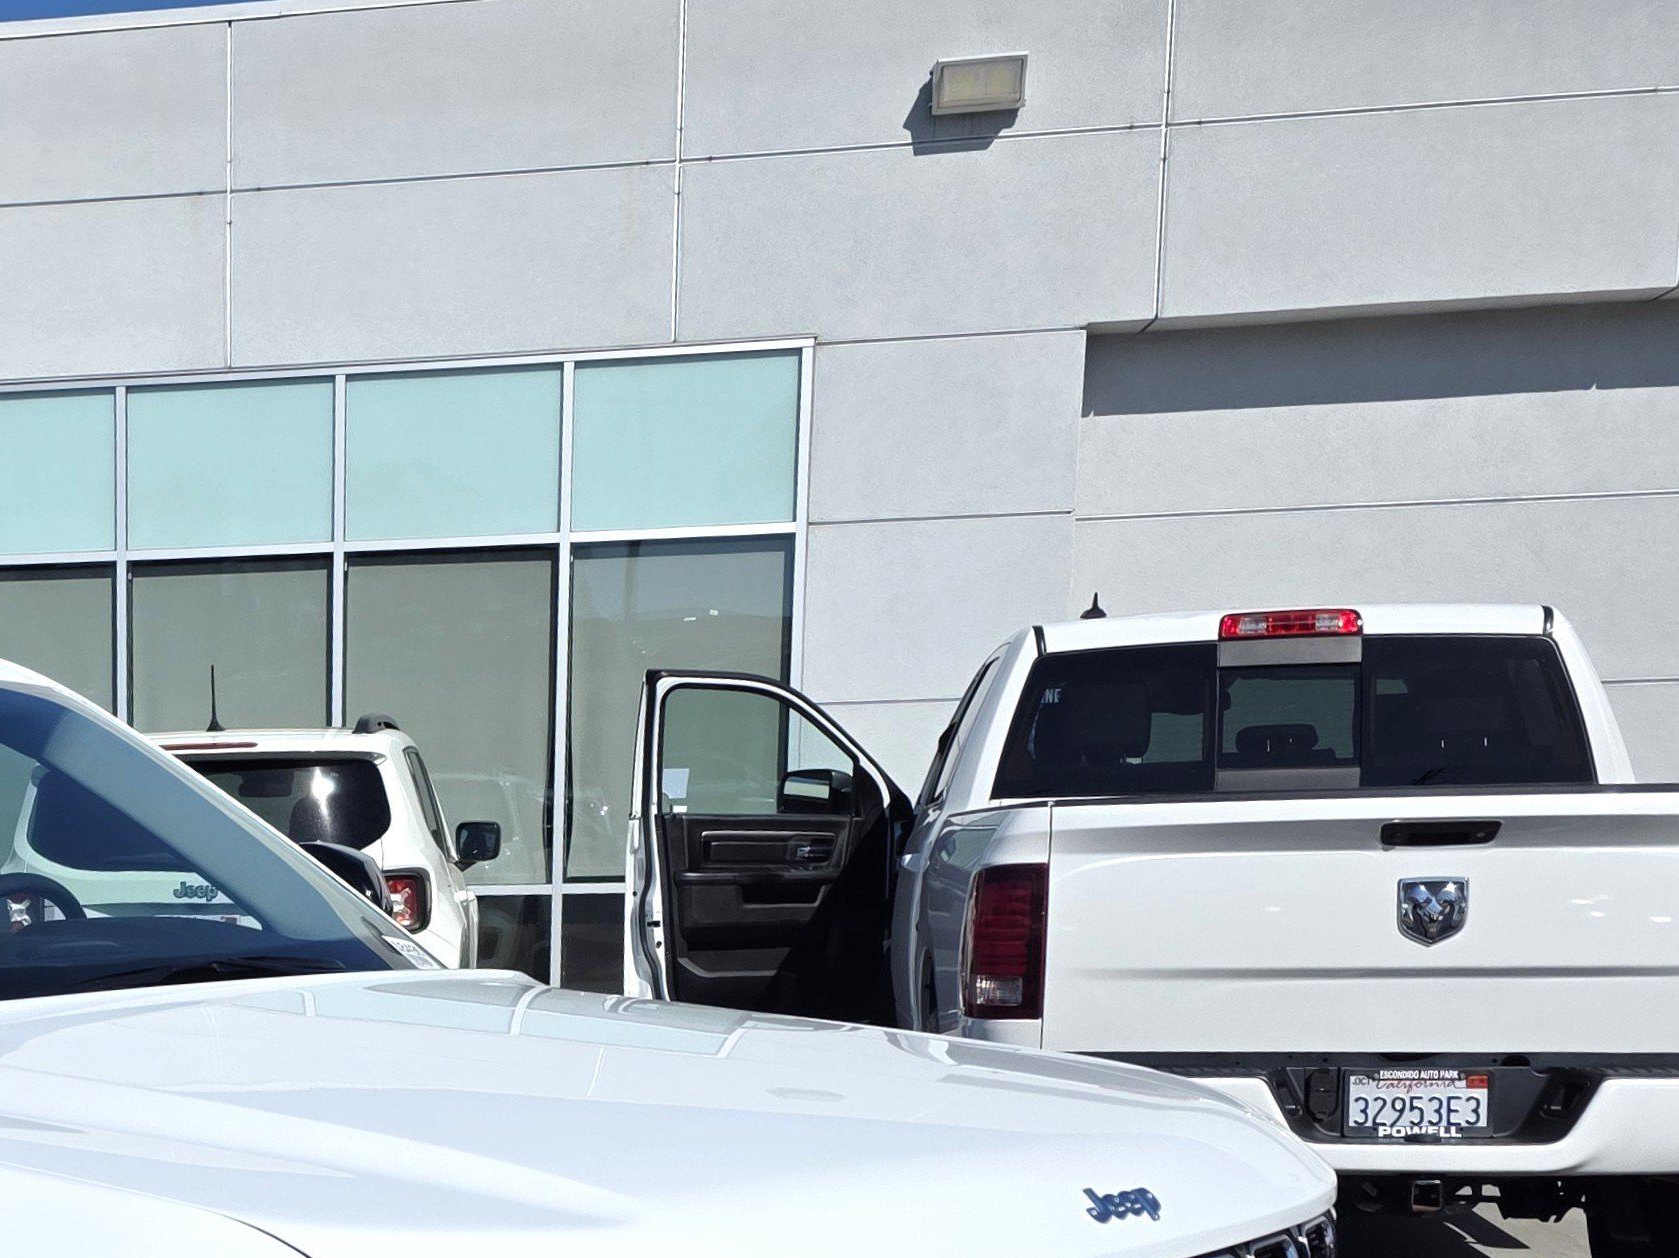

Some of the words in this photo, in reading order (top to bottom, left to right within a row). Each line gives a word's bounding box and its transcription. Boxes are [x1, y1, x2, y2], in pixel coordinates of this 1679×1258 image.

[172, 881, 219, 902] Jeep
[1379, 1069, 1420, 1080] ESCONDIDO
[1419, 1069, 1440, 1080] AUTO
[1439, 1069, 1459, 1080] PARK
[1353, 1095, 1482, 1127] 32953E3
[1377, 1125, 1463, 1138] POWELL
[1081, 1187, 1162, 1225] Jeep
